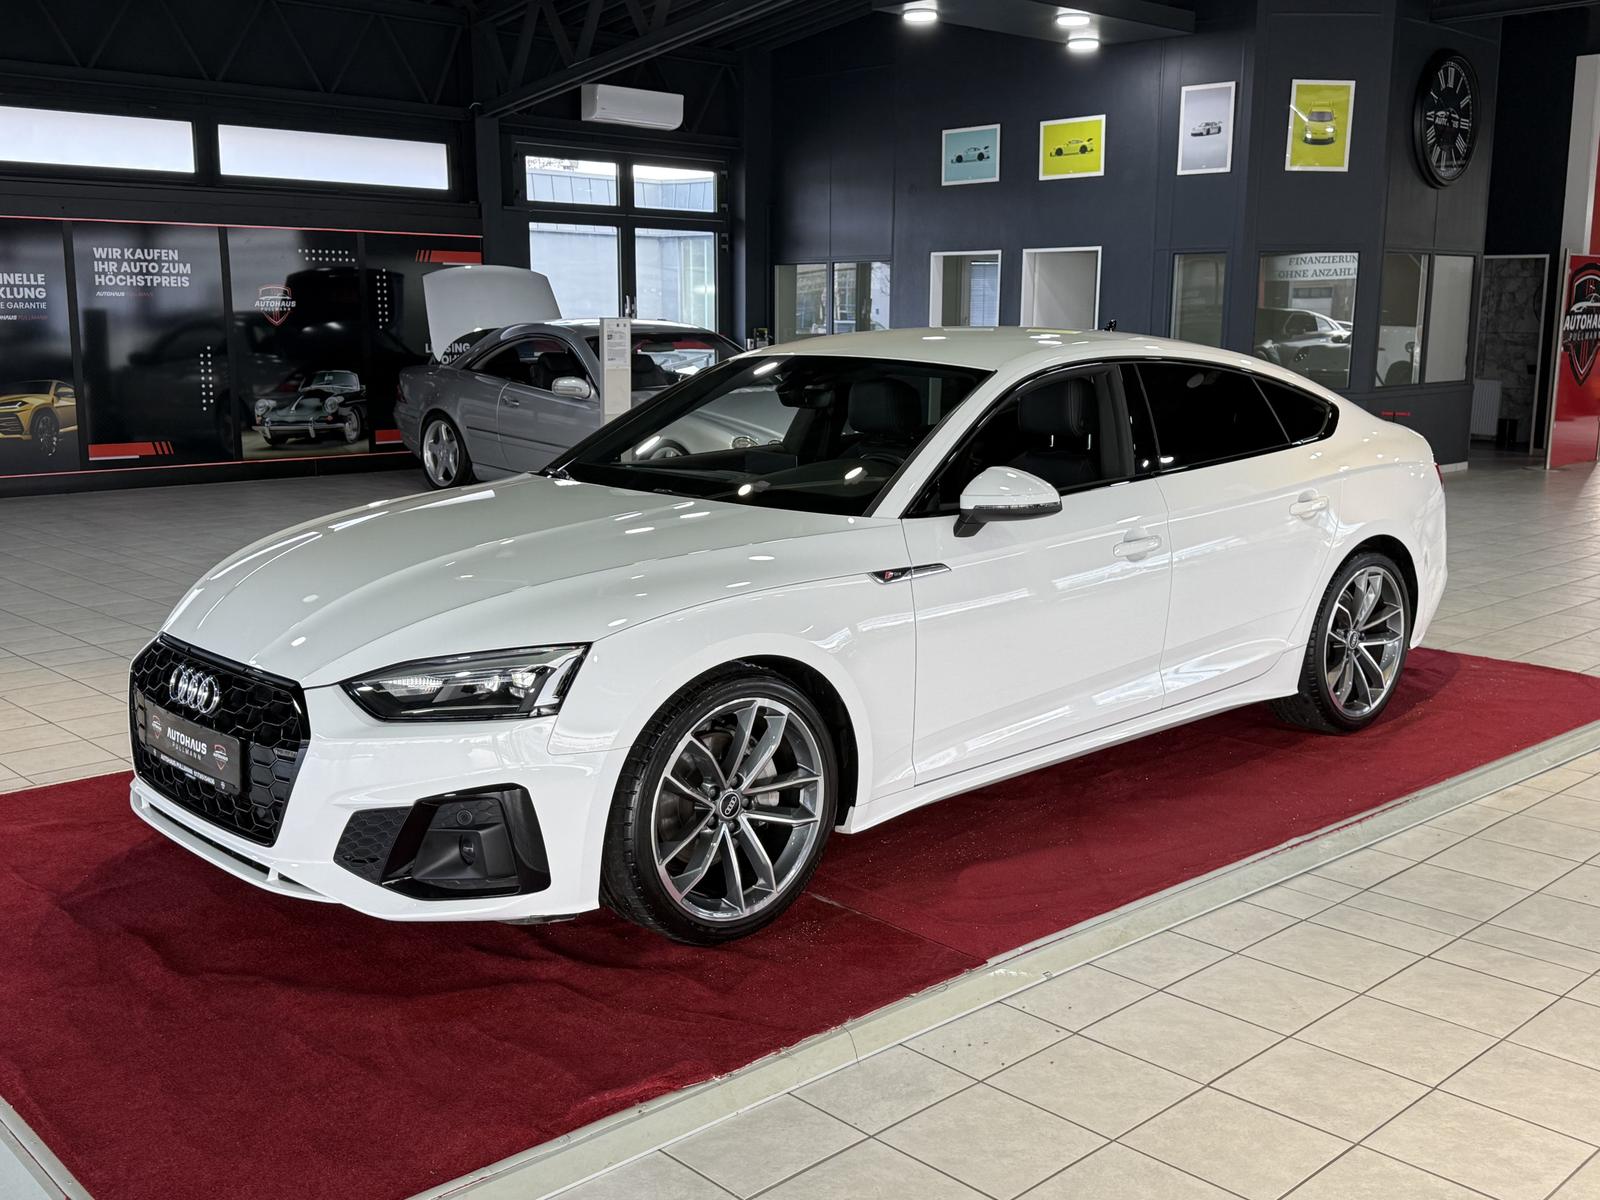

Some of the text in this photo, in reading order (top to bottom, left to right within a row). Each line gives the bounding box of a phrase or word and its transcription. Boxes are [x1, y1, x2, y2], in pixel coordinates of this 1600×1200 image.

[93, 247, 179, 260] WIR KAUFEN
[94, 261, 191, 274] IHR AUTO ZUM
[1278, 269, 1309, 279] OHNE
[95, 271, 190, 287] HÖCHSTPREIS
[425, 343, 470, 353] LSING
[167, 727, 207, 755] AUTOHAUS
